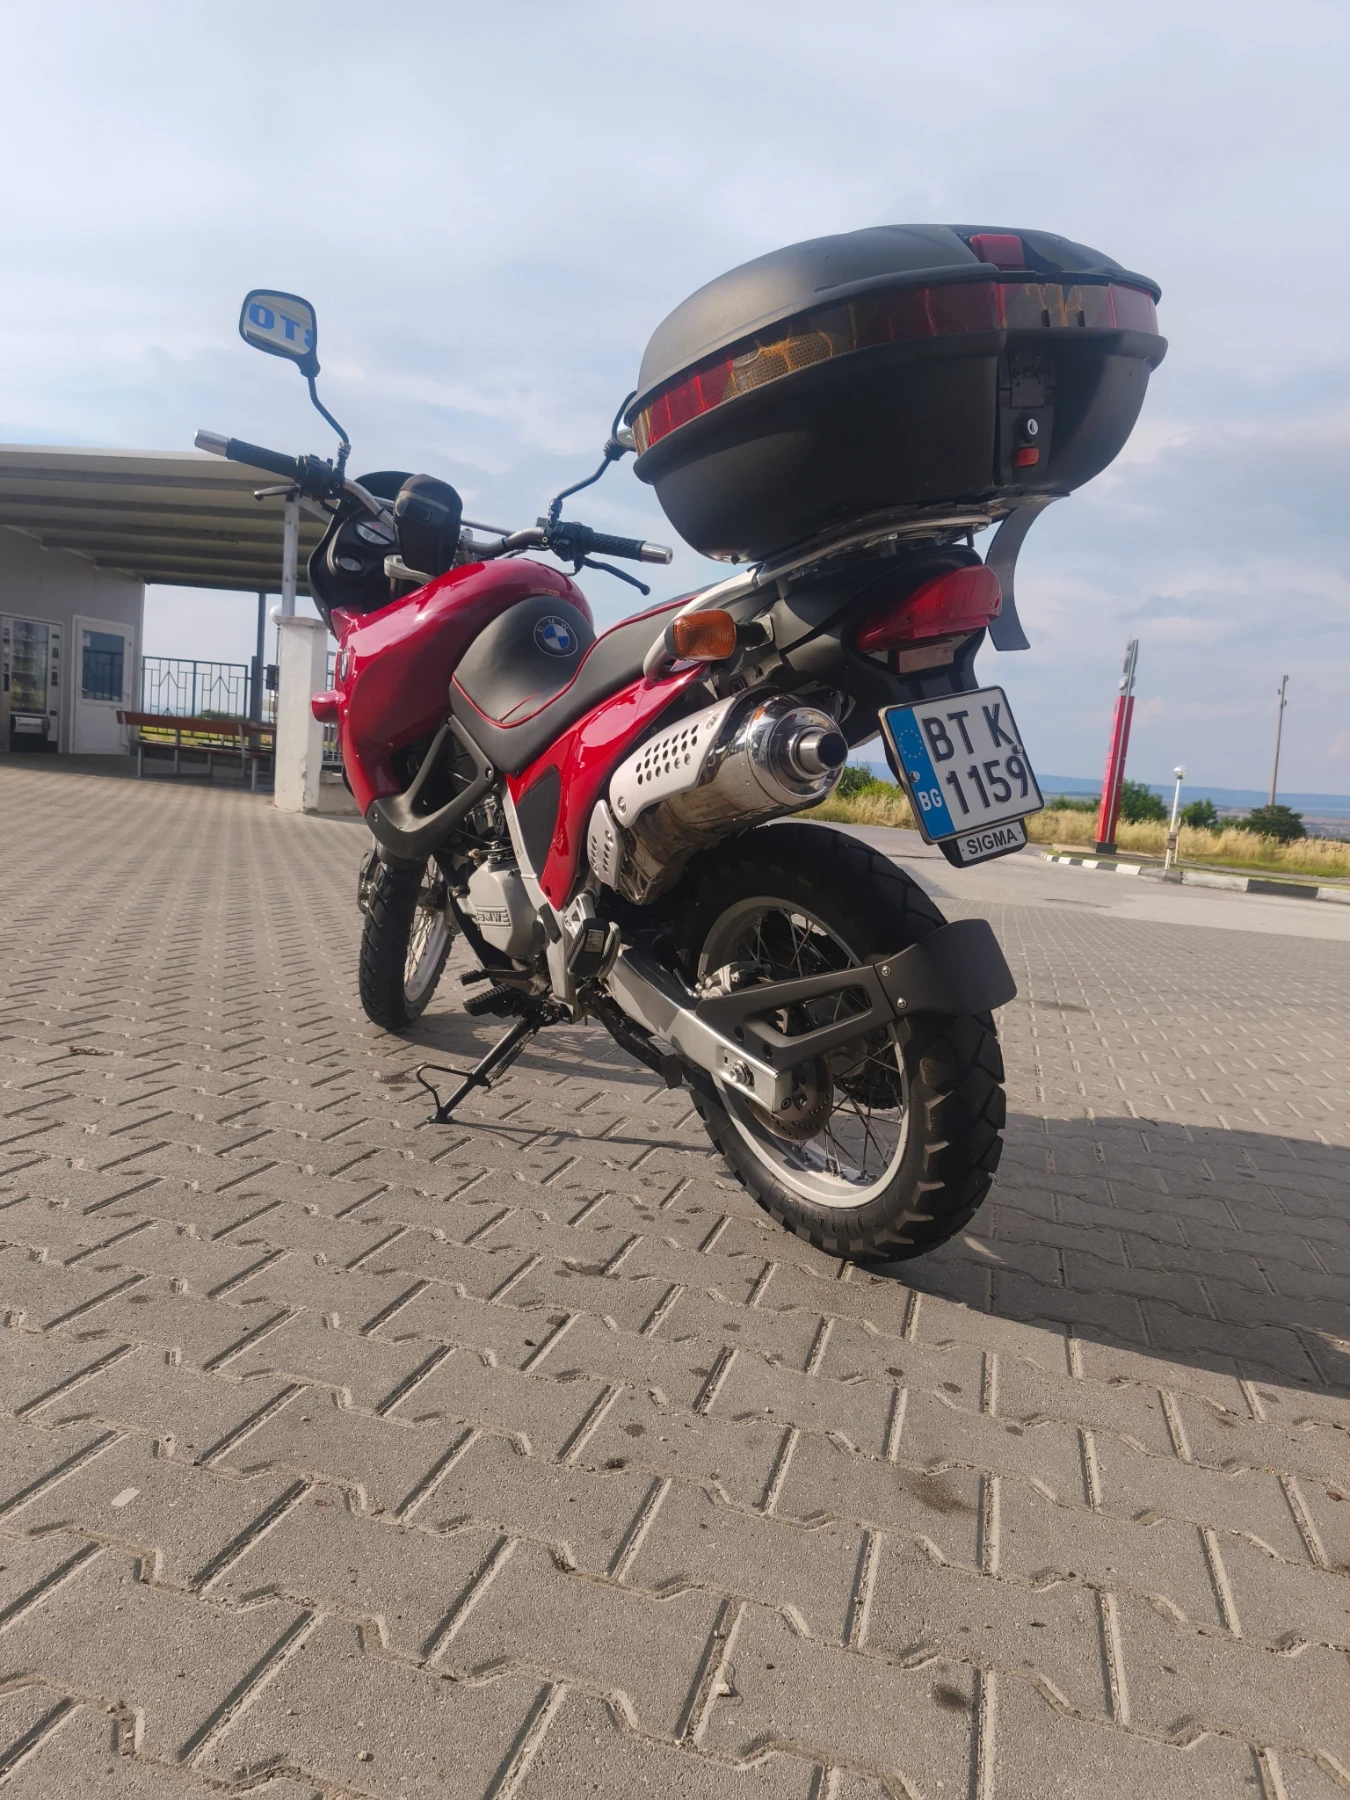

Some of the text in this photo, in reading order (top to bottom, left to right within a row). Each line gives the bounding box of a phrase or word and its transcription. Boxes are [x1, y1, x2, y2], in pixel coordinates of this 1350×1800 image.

[537, 618, 568, 633] BMW
[921, 703, 1014, 763] BT K
[946, 755, 1029, 815] 1159
[918, 788, 942, 811] BG
[966, 828, 1018, 855] SIGMA
